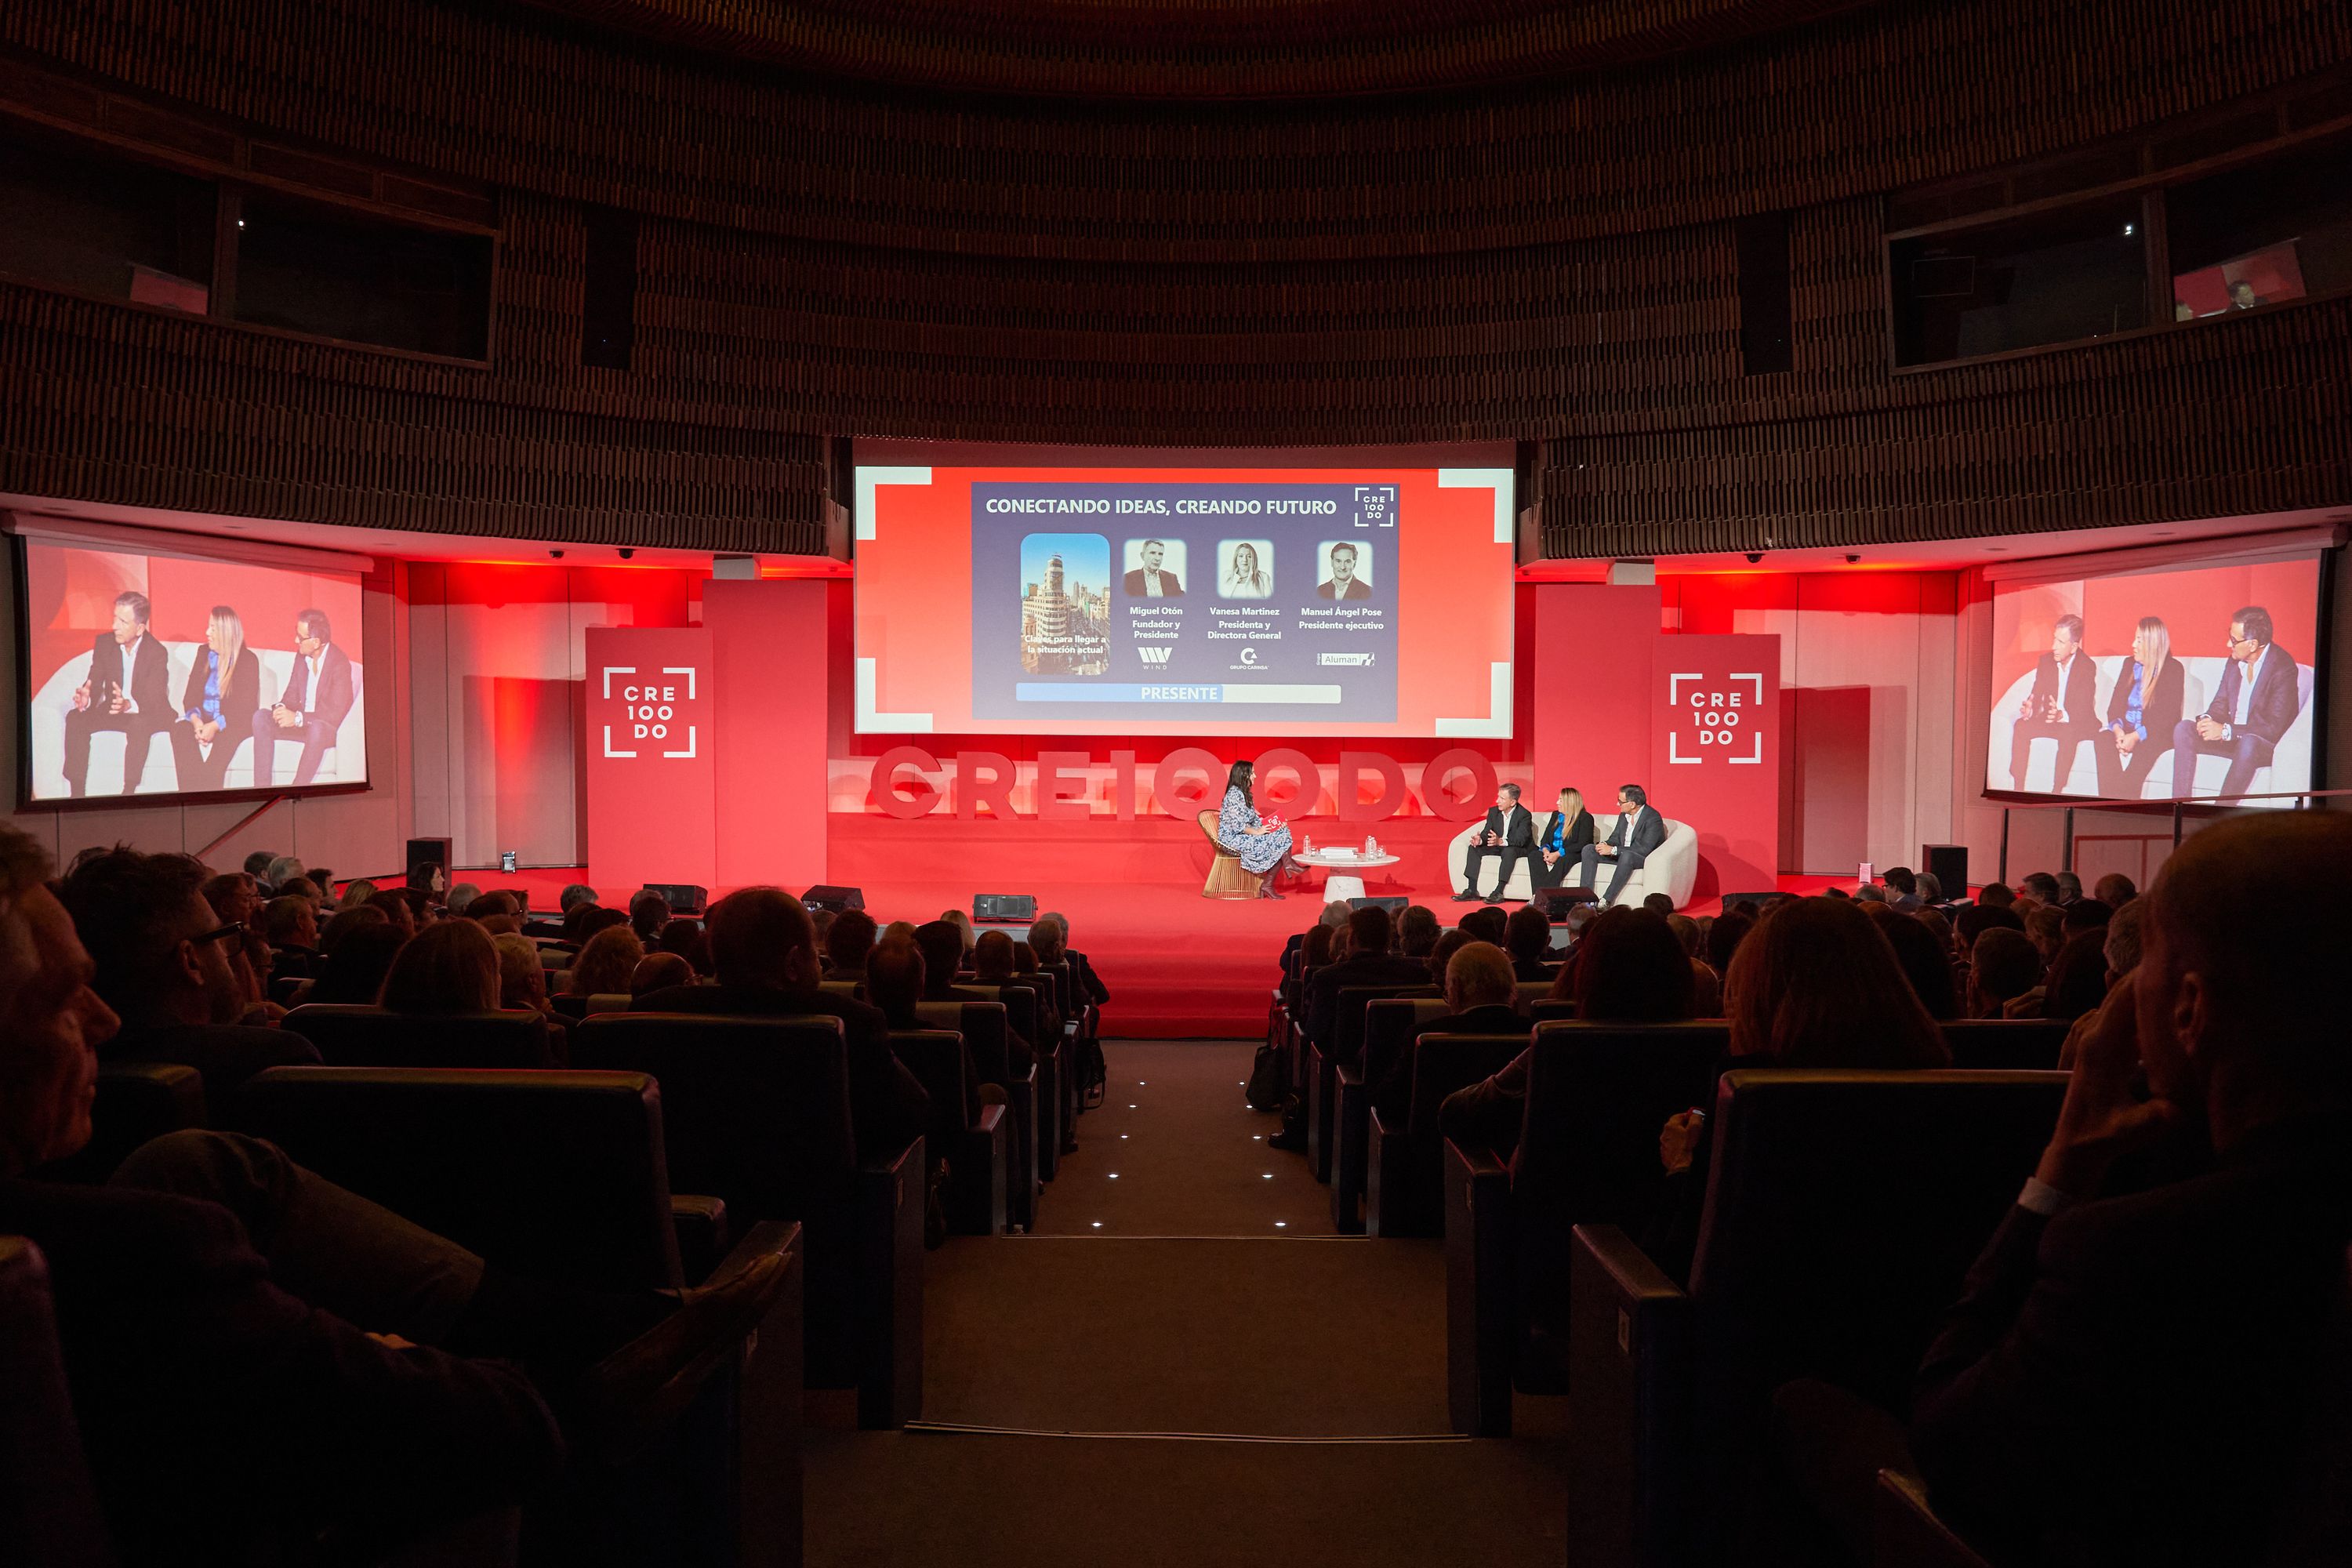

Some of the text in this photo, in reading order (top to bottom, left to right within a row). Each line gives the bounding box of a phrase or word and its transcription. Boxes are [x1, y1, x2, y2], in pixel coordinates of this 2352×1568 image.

[985, 499, 1338, 516] CONECTANDO IDEAS, CREANDO FUTURO
[1130, 606, 1183, 616] Miguel Otón
[1209, 607, 1240, 615] Vanesa
[1301, 606, 1382, 618] Manuel Ángel Pose
[1132, 619, 1181, 630] Fundador y
[1218, 620, 1271, 630] Presidenta y
[1298, 621, 1385, 631] Presidente ejecutivo
[1074, 635, 1099, 644] llegar
[1134, 630, 1179, 639] Presidente
[1207, 630, 1282, 640] Directora General
[1037, 645, 1076, 654] situación
[624, 686, 675, 702] CRE
[1141, 687, 1218, 700] PRESENTE
[1690, 692, 1741, 708] CRE
[627, 705, 673, 720] 100
[1693, 711, 1739, 727] 100
[634, 724, 667, 739] DO
[1700, 730, 1733, 745] DO
